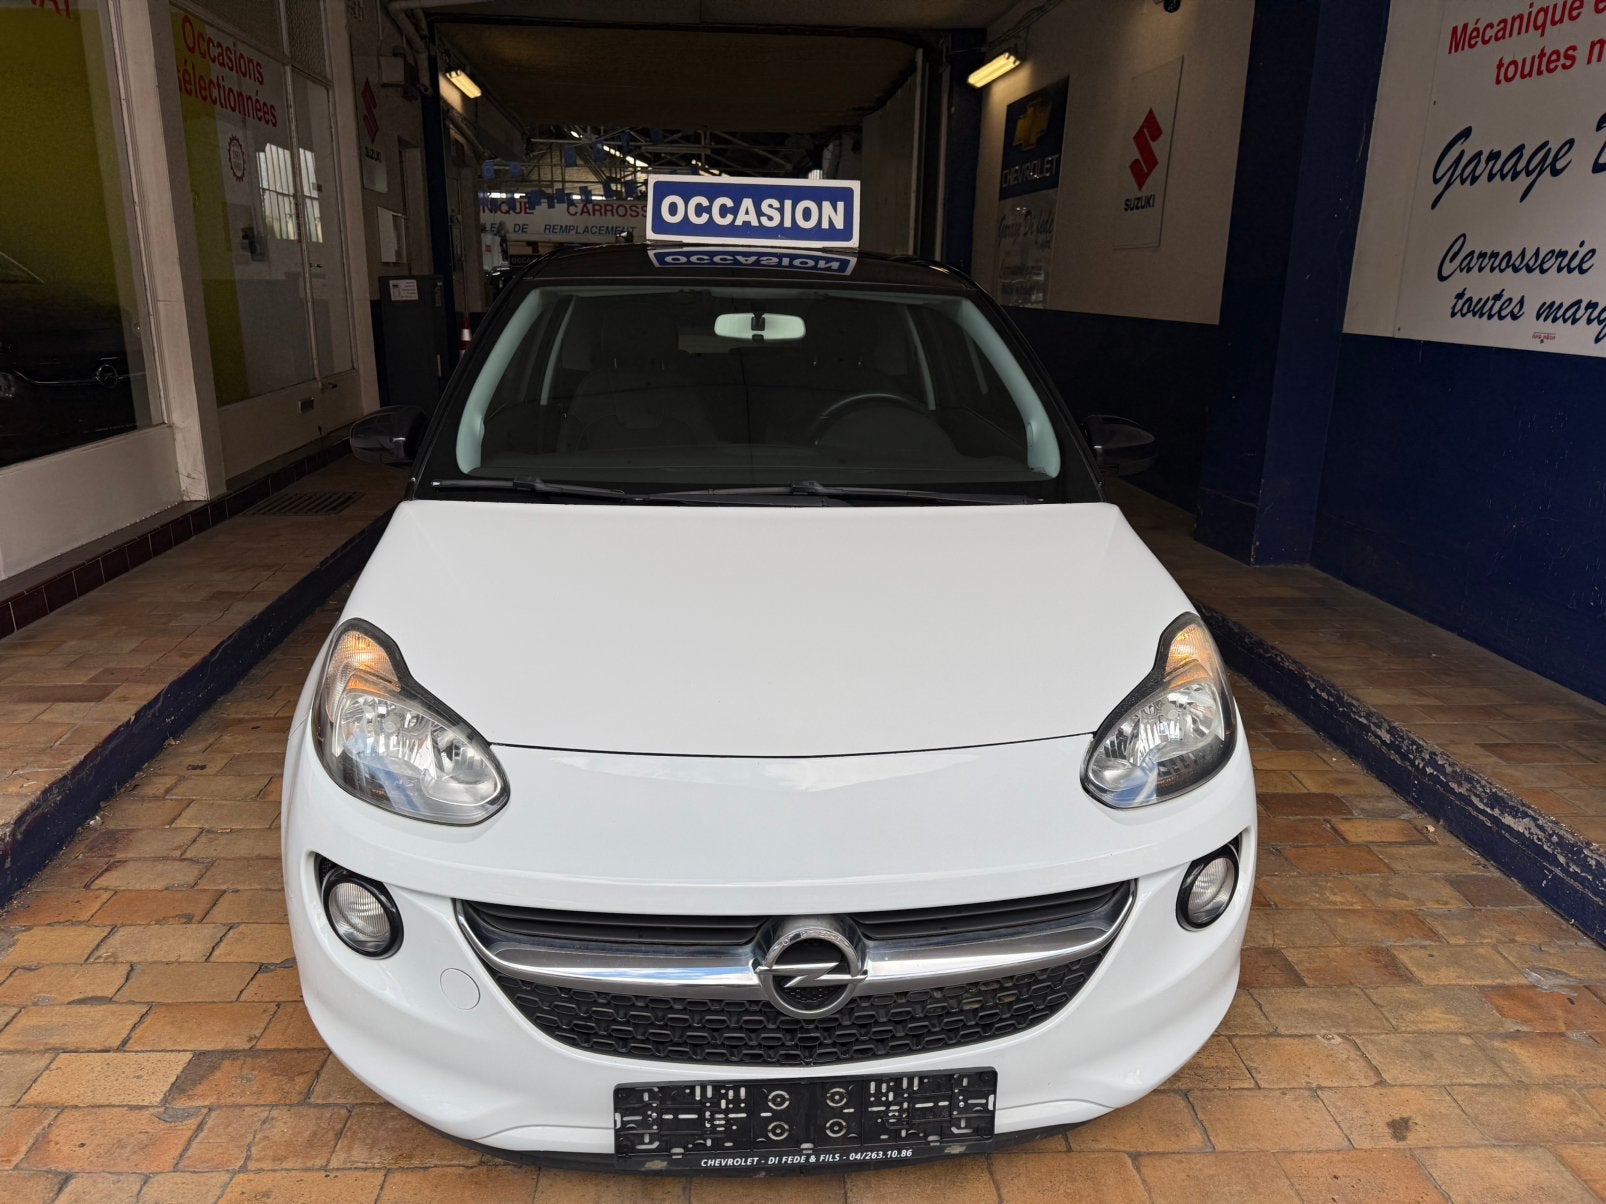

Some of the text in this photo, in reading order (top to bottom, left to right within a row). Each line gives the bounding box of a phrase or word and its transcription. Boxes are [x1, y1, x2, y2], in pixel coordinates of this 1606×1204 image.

[1448, 0, 1584, 54] Mécanique
[181, 15, 264, 86] Occasions
[1495, 45, 1578, 85] toutes
[1431, 125, 1575, 210] Garage
[660, 194, 845, 230] OCCASION
[1123, 194, 1156, 211] SUZUKI
[513, 223, 529, 233] DE
[1437, 232, 1597, 282] Carrosserie
[1450, 287, 1525, 321] toutes
[701, 1157, 759, 1167] CHEVROLET
[768, 1156, 779, 1165] DI
[781, 1155, 806, 1164] FEDE
[809, 1155, 816, 1163] &
[819, 1153, 840, 1162] FILS
[849, 1149, 913, 1160] 04/263.10.86
